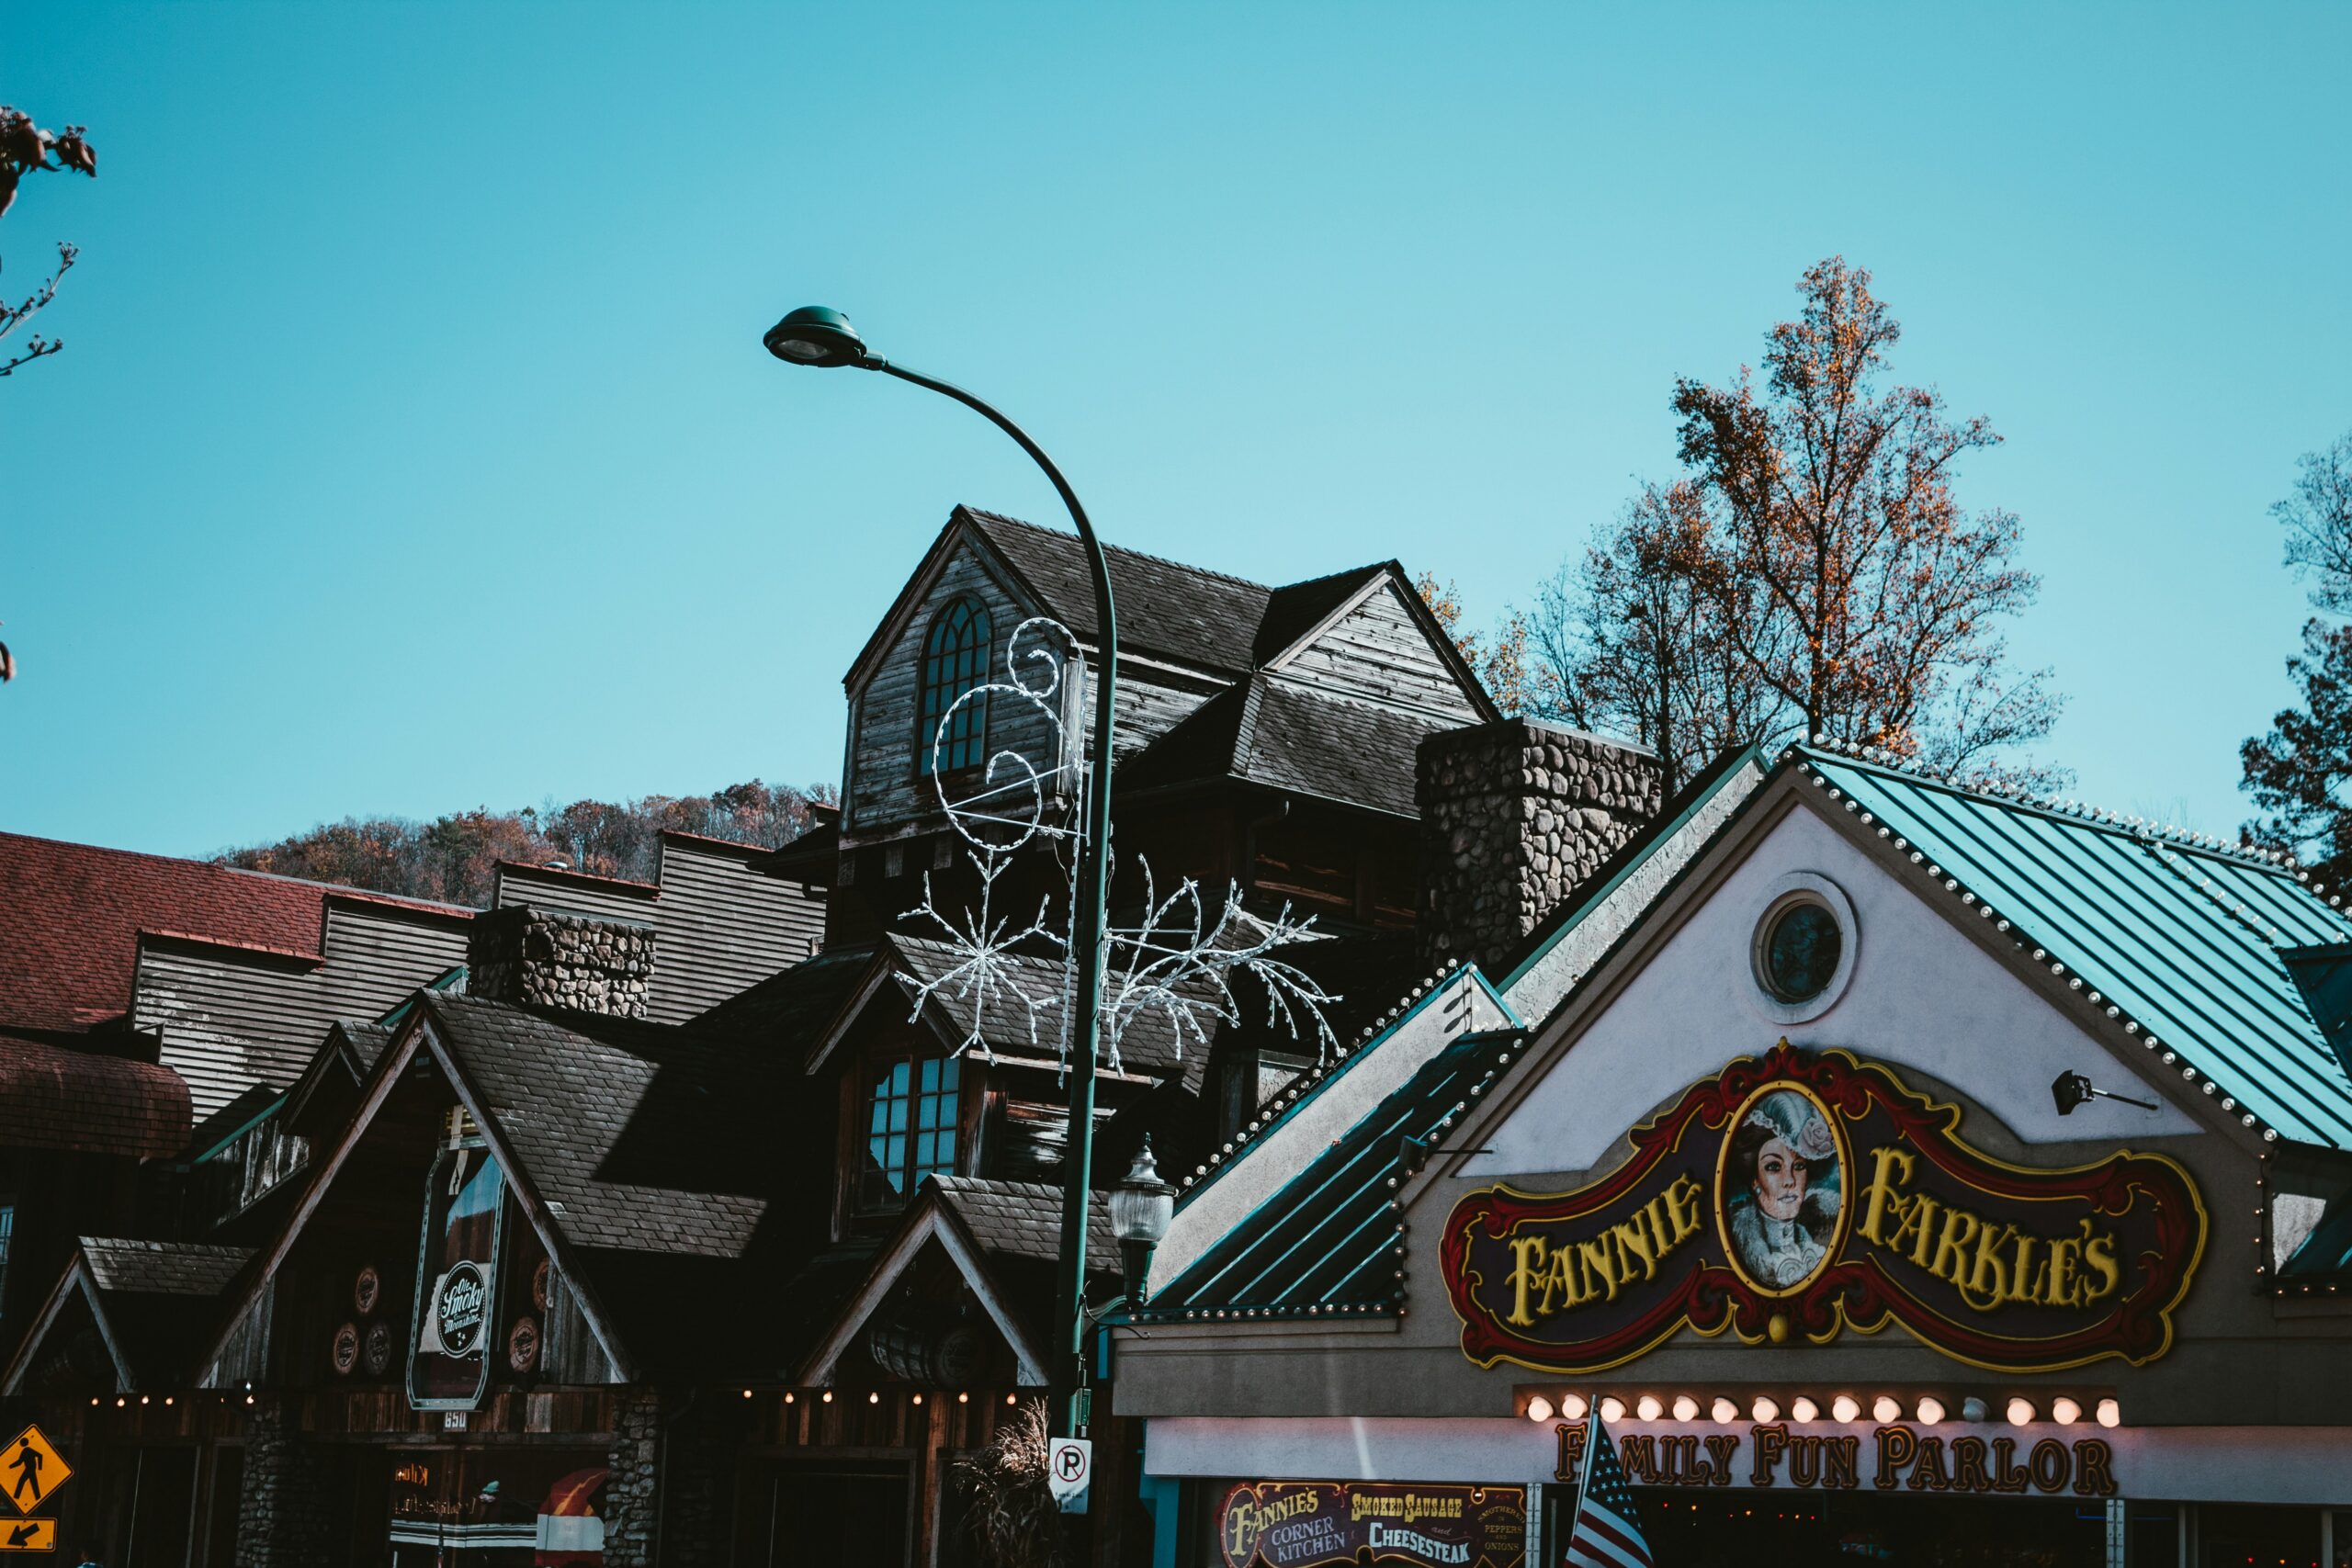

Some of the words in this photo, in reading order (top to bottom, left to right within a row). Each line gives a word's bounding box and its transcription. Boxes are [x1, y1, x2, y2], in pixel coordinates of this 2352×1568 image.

[1505, 1172, 1702, 1327] FANNIE
[1856, 1146, 2120, 1312] FARKLE'S
[441, 1281, 484, 1318] Smoky
[445, 1314, 481, 1334] Moonshine
[445, 1411, 467, 1428] 650
[1063, 1451, 1080, 1477] P
[1554, 1422, 1740, 1485] FMILY
[1749, 1423, 1860, 1489] FUN
[1873, 1424, 2118, 1496] PARLOR
[1229, 1486, 1319, 1557] FANNIE'S
[1351, 1493, 1404, 1522] SMOKED
[1404, 1494, 1463, 1523] SAUSAGE
[1477, 1506, 1525, 1524] SMOTHERED
[1271, 1516, 1335, 1546] CORNER
[1369, 1521, 1470, 1564] CHEESESTEAK
[1430, 1525, 1453, 1537] and
[1485, 1525, 1522, 1534] PEPPERS
[1277, 1531, 1345, 1562] KITCHEN
[1485, 1542, 1519, 1551] ONIONS
